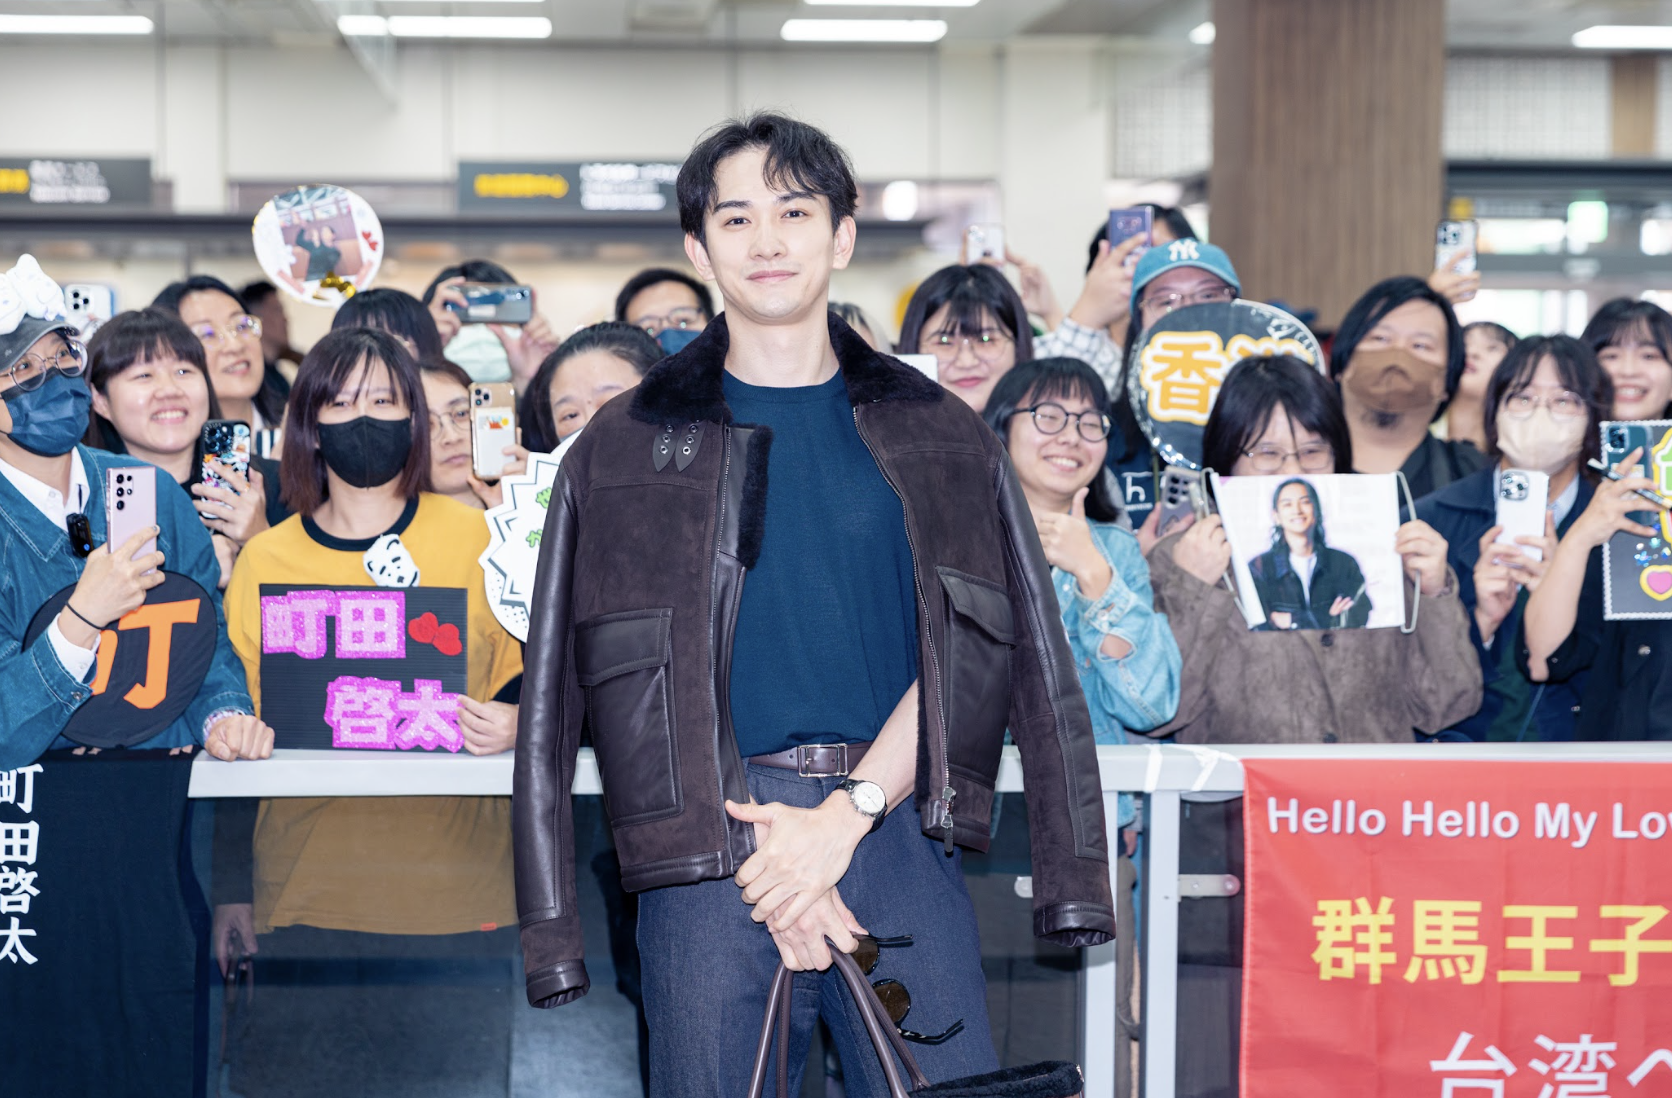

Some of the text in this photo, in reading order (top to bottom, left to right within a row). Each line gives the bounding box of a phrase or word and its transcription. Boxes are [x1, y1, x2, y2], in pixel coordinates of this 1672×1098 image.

[261, 590, 406, 659] 町田
[324, 676, 466, 753] 啓太
[1267, 797, 1672, 848] Hello Hello My Lo
[1311, 896, 1672, 986] 群馬王子
